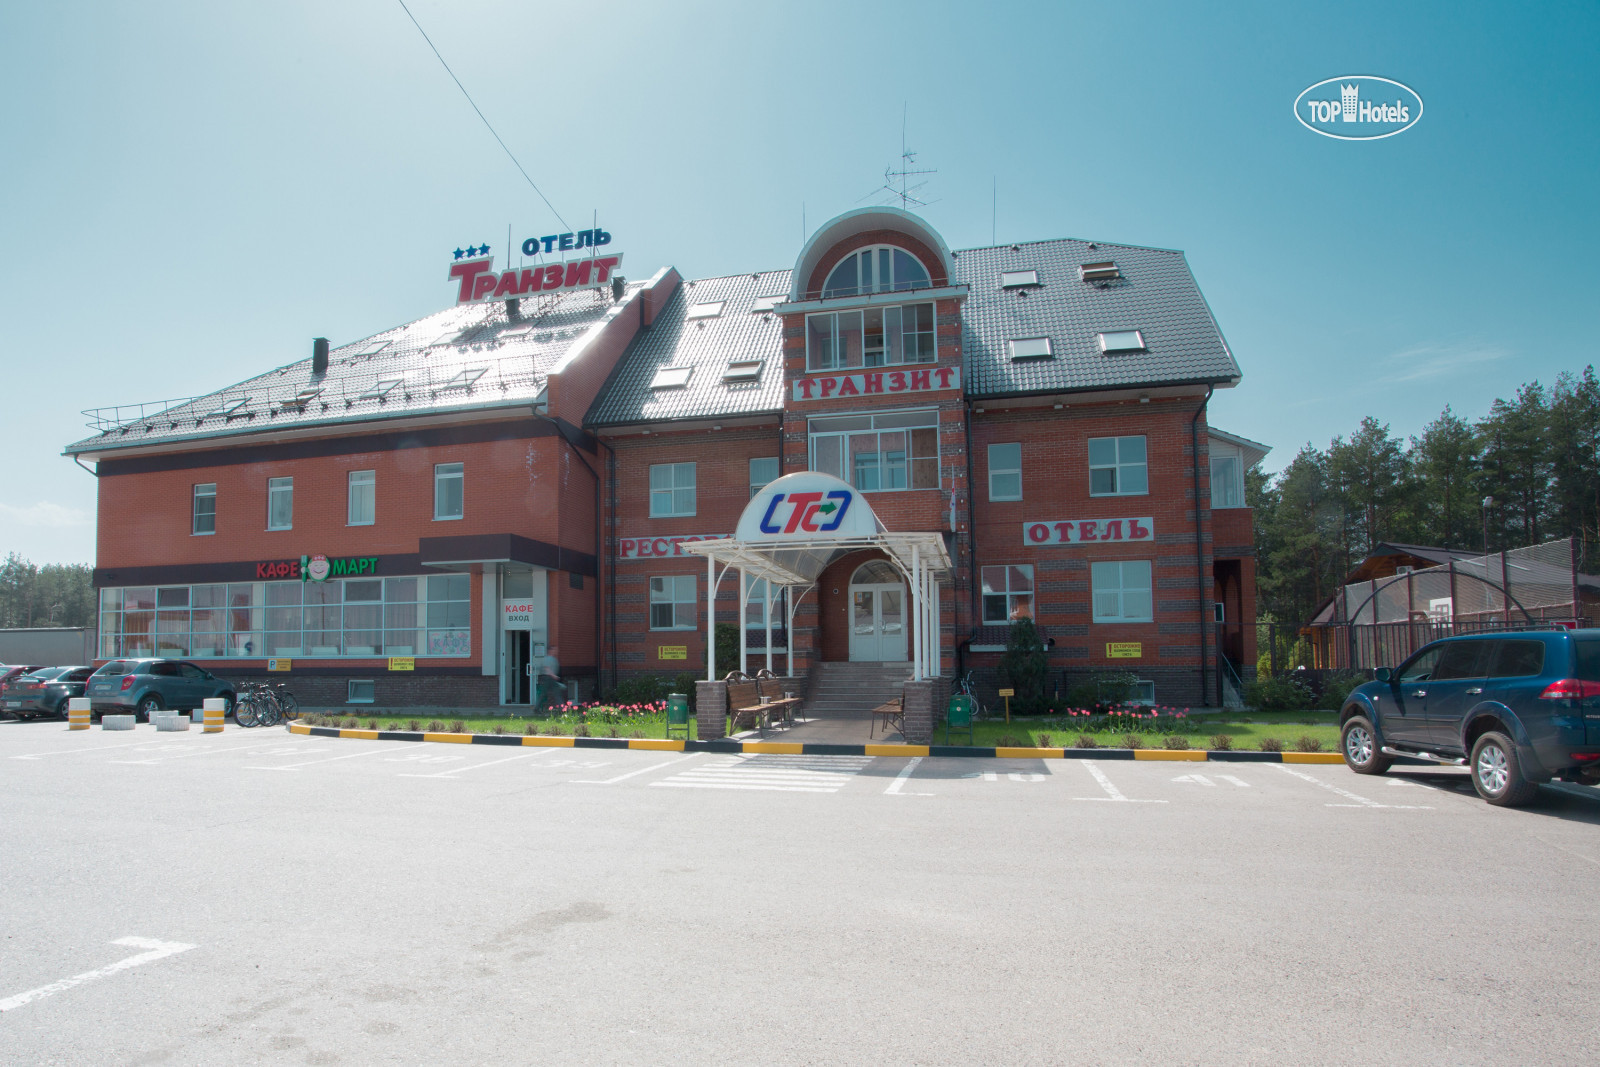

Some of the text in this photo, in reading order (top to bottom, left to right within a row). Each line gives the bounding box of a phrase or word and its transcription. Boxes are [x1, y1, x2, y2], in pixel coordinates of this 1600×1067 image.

[522, 228, 612, 256] ОТЕЛЬ
[450, 257, 619, 303] ТРАНЗИТ
[797, 367, 954, 399] ТРАНЗИТ
[1029, 519, 1149, 543] ОТЕЛЬ
[256, 557, 378, 578] КАФЕ МАРТ
[505, 604, 534, 613] КАФЕ
